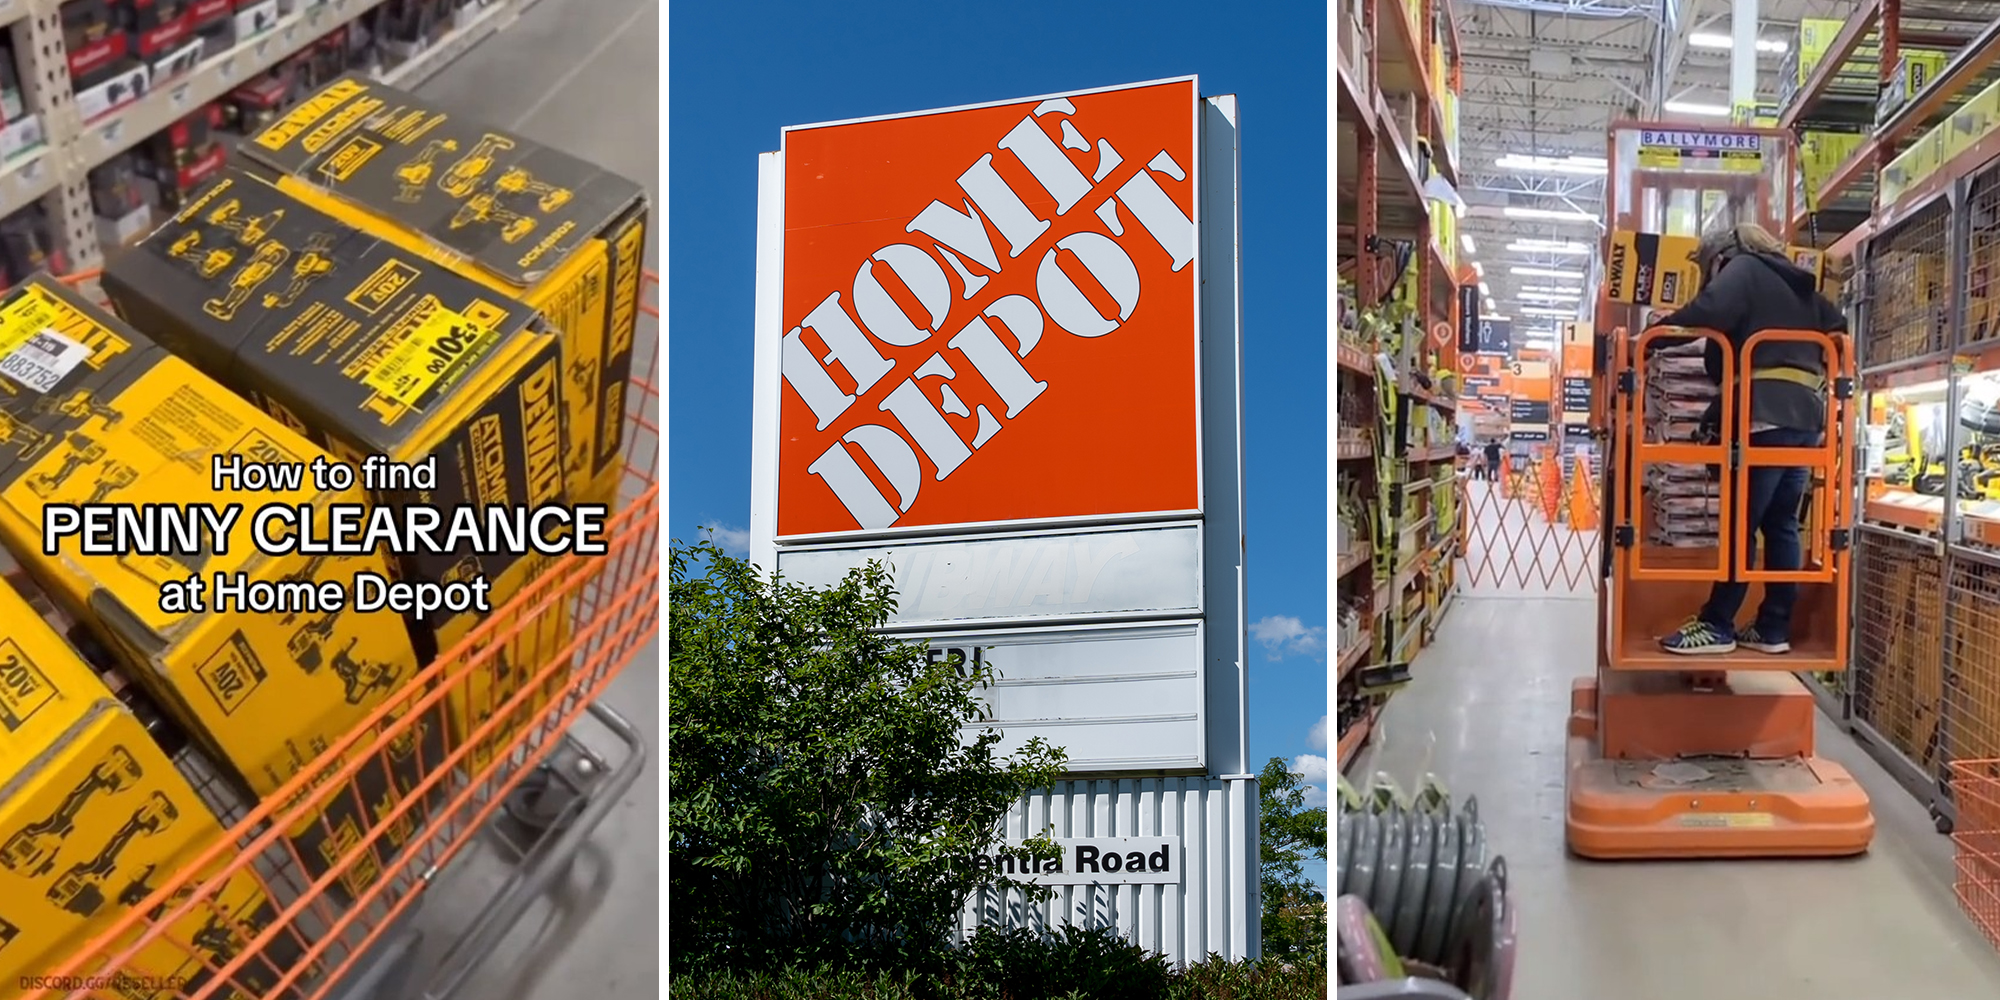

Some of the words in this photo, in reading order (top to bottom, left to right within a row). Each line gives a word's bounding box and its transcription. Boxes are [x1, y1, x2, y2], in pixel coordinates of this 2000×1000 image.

[1644, 132, 1757, 147] BALLYMORE
[782, 97, 1125, 431] HOME
[808, 149, 1194, 530] DEPOT
[1567, 324, 1576, 342] 1
[1513, 363, 1523, 376] 3
[888, 533, 1140, 612] UBWAY
[1075, 844, 1170, 874] Road
